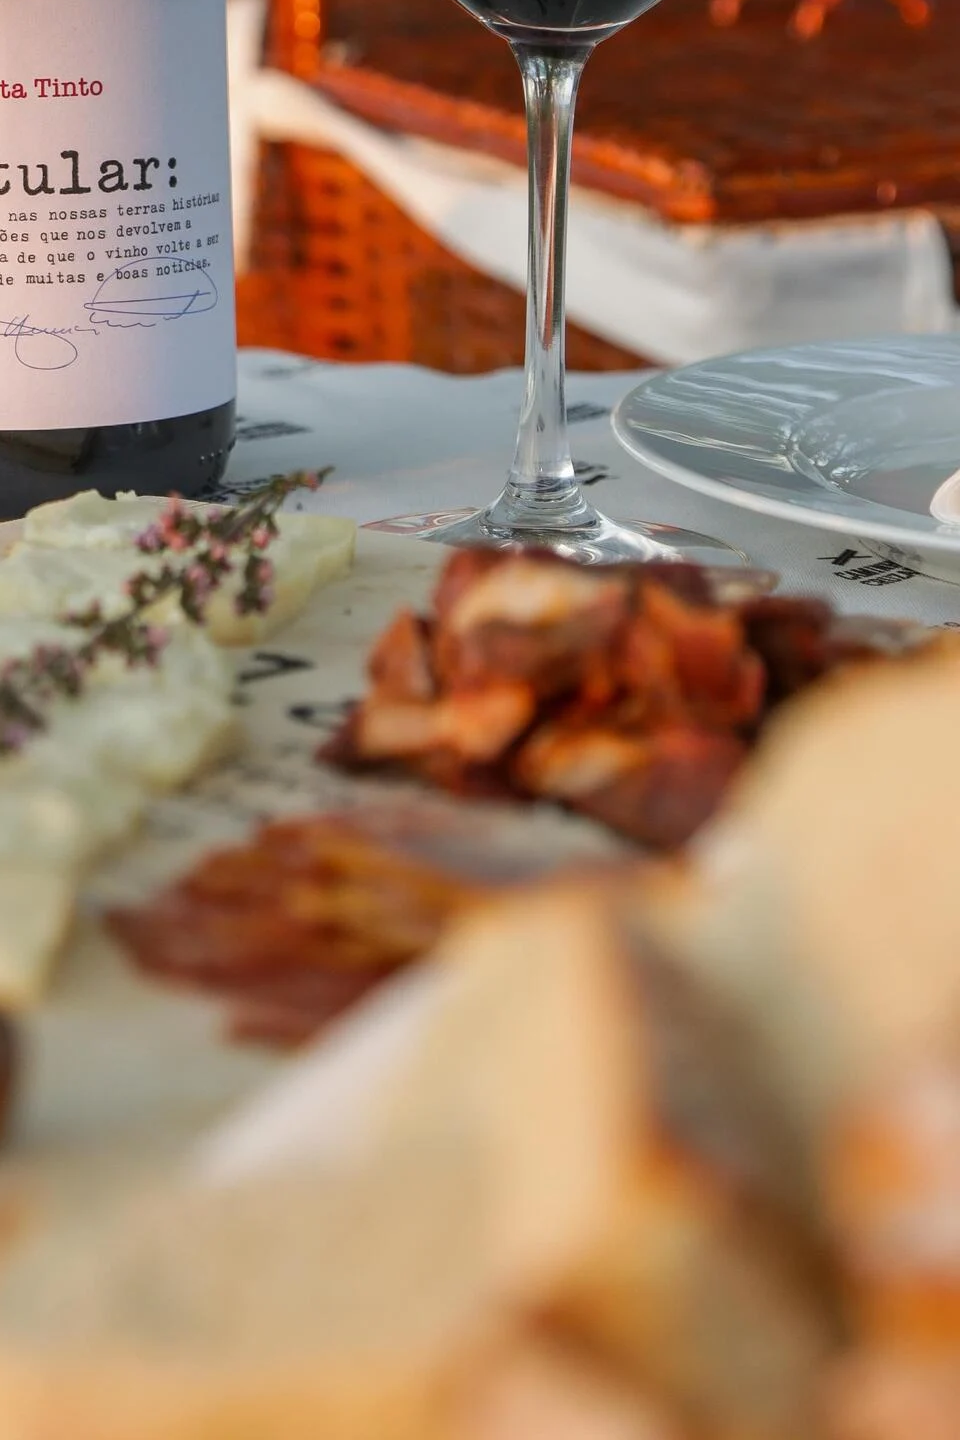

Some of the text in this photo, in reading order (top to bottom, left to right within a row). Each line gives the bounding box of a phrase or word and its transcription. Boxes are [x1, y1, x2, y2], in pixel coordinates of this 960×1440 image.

[34, 77, 103, 98] Tinto
[8, 211, 38, 222] nas
[49, 208, 107, 221] nossas
[117, 202, 166, 217] terras
[173, 191, 221, 211] histórias
[40, 231, 69, 243] que
[77, 229, 107, 240] nos
[116, 221, 181, 237] devolvem
[185, 219, 192, 229] a
[17, 252, 36, 263] de
[47, 252, 75, 265] que
[87, 251, 95, 261] o
[105, 245, 148, 259] vinho
[156, 240, 191, 255] volte
[196, 238, 202, 248] a
[207, 234, 219, 246] ser
[26, 272, 85, 284] muitas
[97, 273, 105, 282] e
[116, 268, 149, 280] boas
